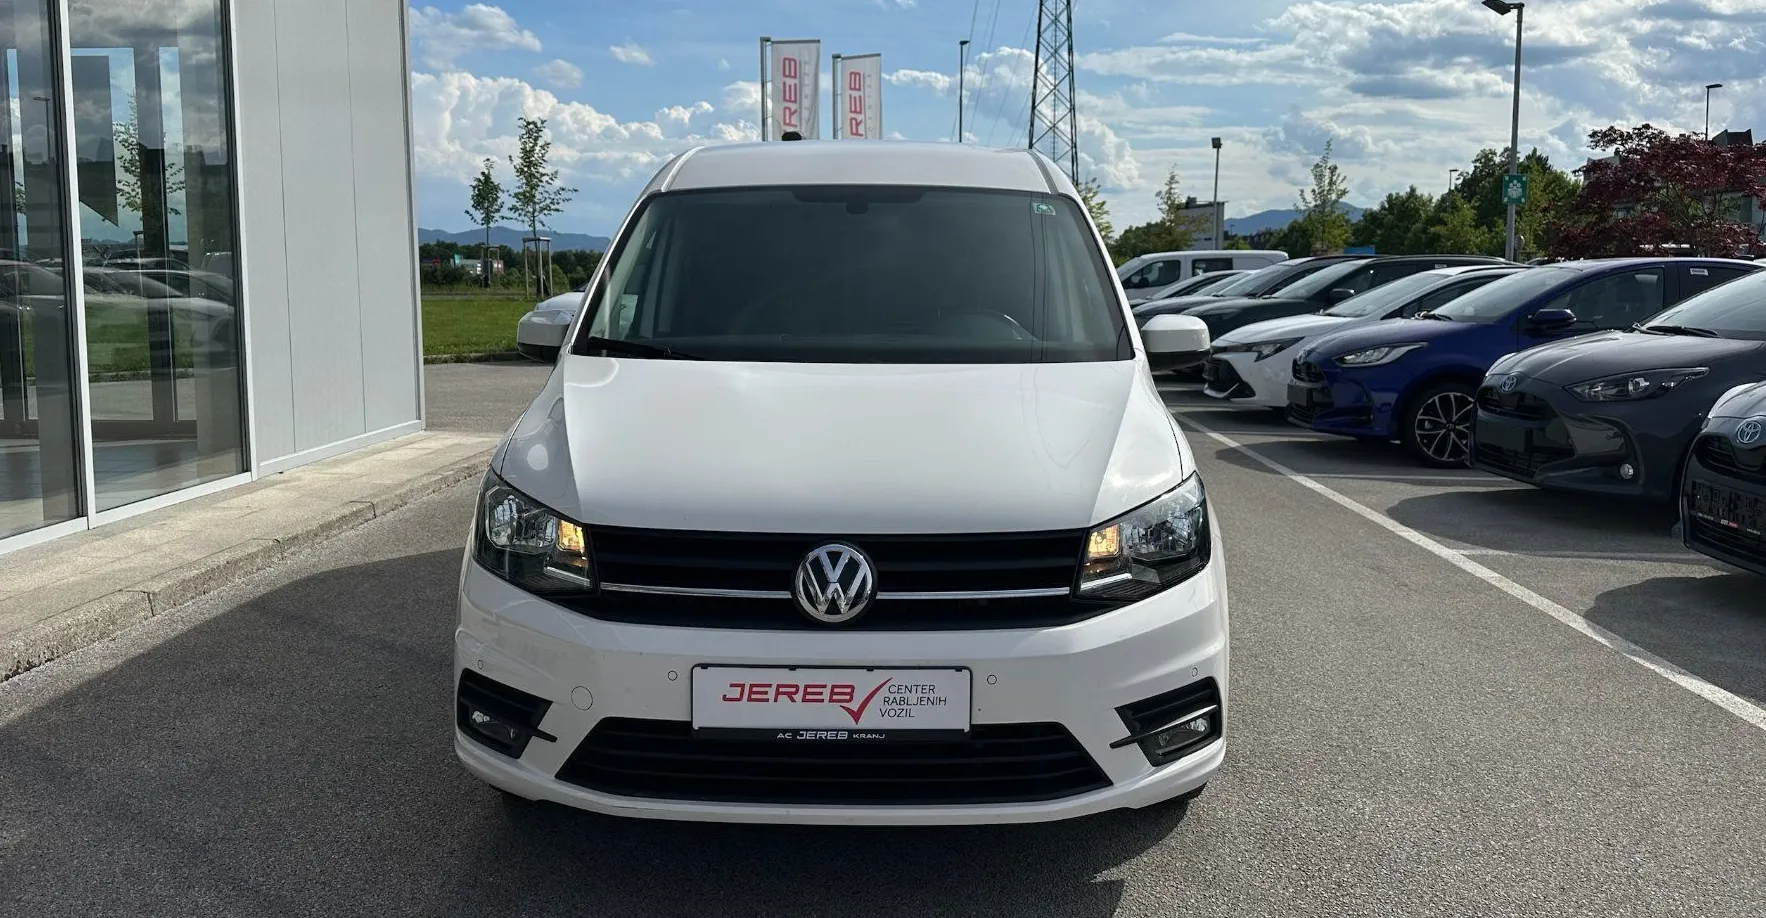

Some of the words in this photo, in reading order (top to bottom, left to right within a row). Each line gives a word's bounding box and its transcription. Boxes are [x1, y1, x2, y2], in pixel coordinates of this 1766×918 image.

[782, 57, 798, 128] REB
[849, 71, 863, 137] REB
[795, 543, 873, 623] VW
[722, 683, 855, 703] JEREB
[888, 684, 936, 694] CENTER
[883, 696, 947, 706] RABLJENIH
[879, 708, 915, 718] VOZIL
[797, 731, 848, 740] JEREB
